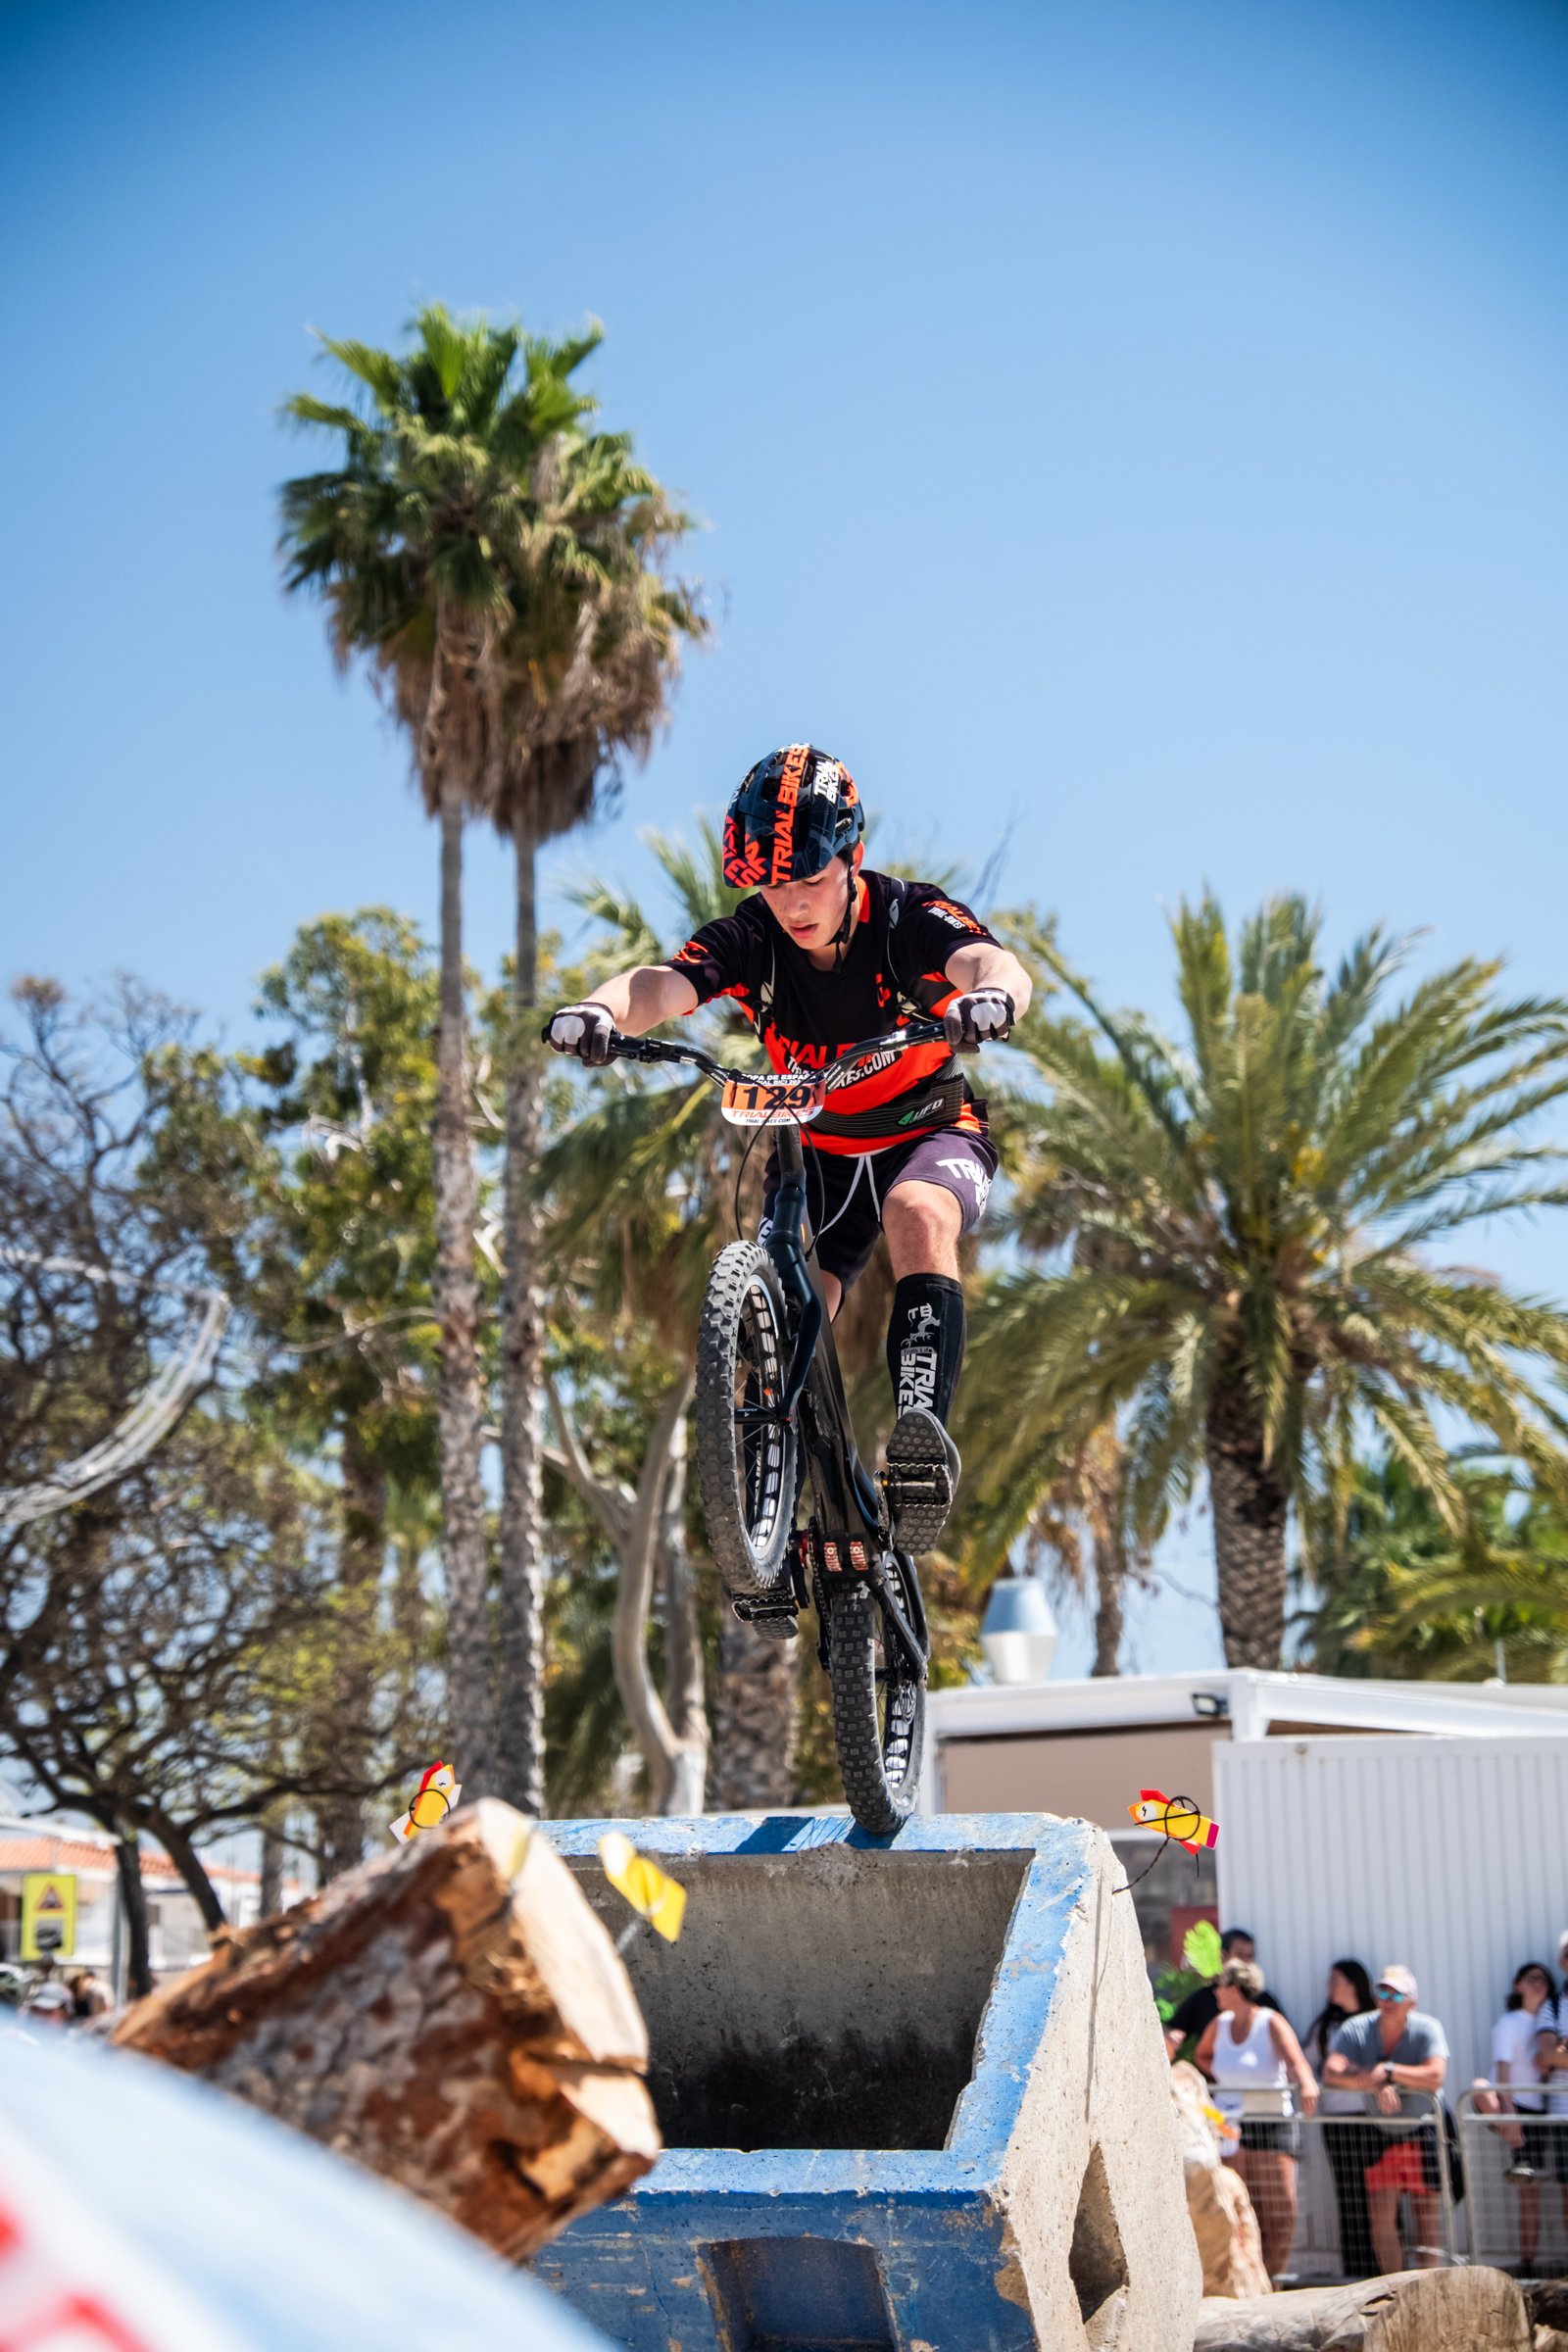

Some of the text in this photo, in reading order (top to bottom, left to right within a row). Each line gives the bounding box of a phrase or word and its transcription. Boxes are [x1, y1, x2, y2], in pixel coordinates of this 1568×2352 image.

[743, 1085, 811, 1109] 129
[731, 1107, 815, 1119] TRIALBIKES
[913, 1098, 945, 1121] UFO
[913, 1353, 938, 1410] TRIA
